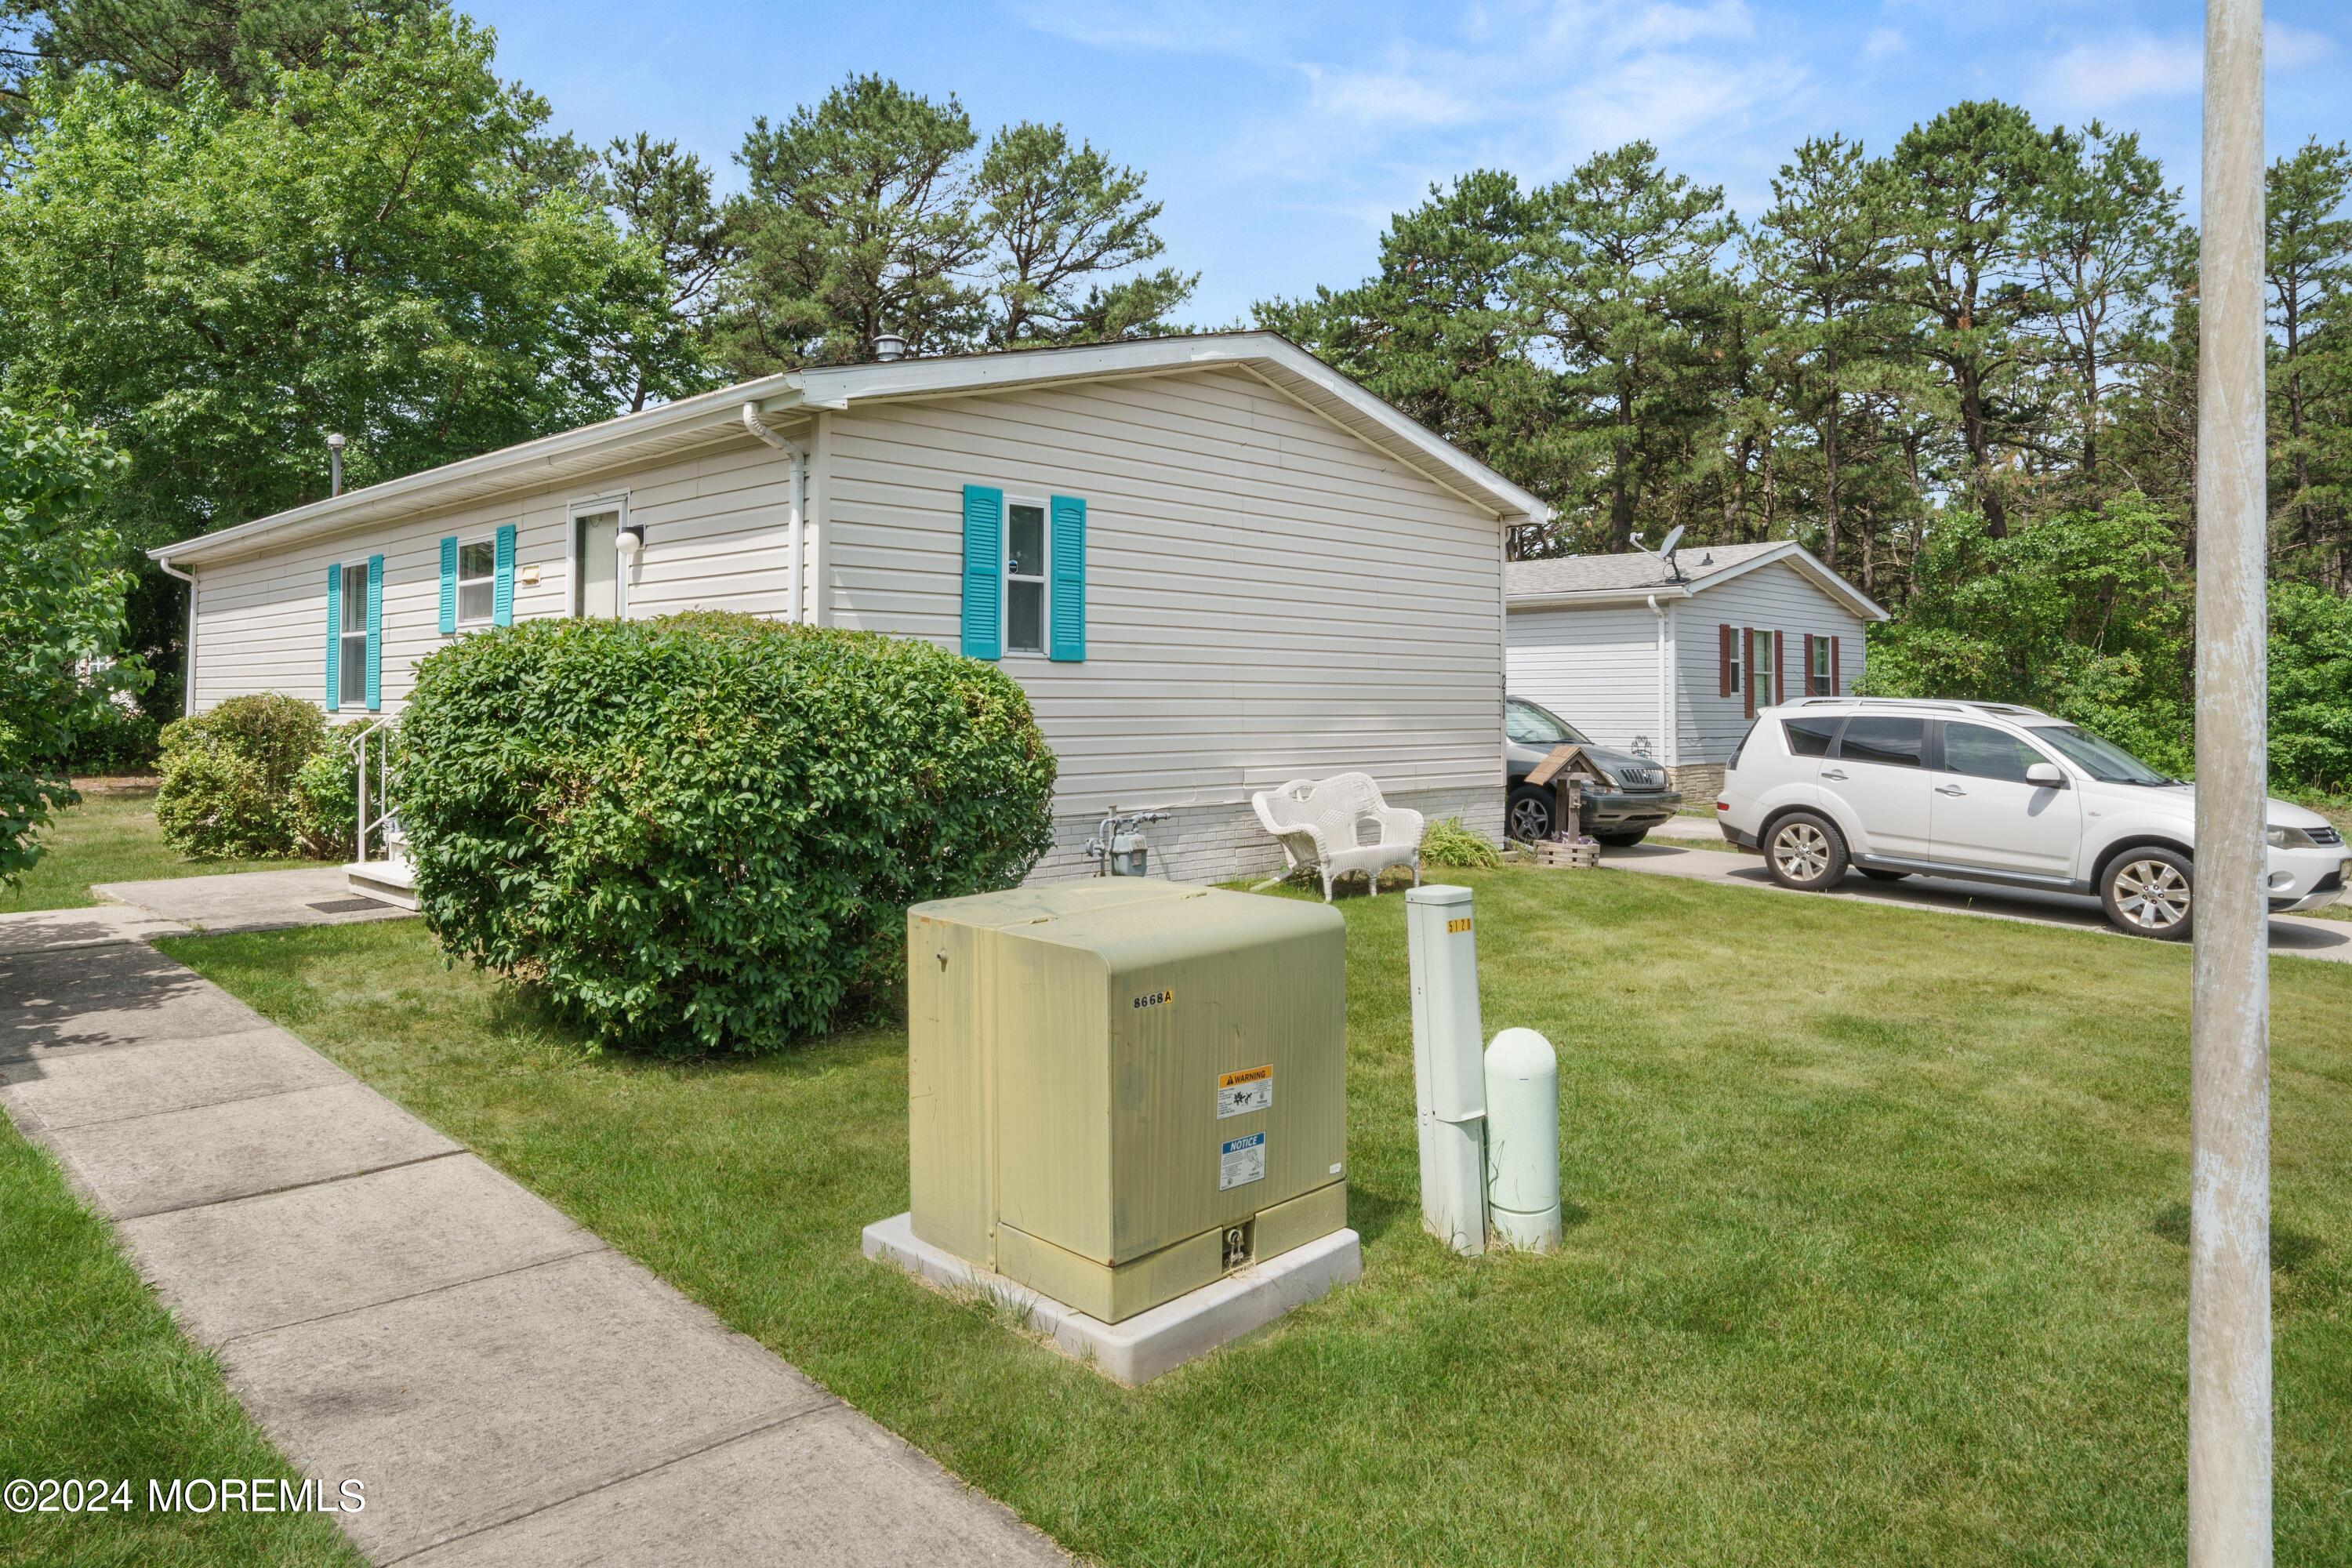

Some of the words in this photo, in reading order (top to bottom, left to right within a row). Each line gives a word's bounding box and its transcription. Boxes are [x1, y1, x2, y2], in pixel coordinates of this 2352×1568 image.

[1449, 918, 1471, 932] 5120
[1134, 991, 1171, 1008] 8668A
[1235, 1070, 1265, 1083] WARNING
[1230, 1136, 1258, 1151] NOTICE
